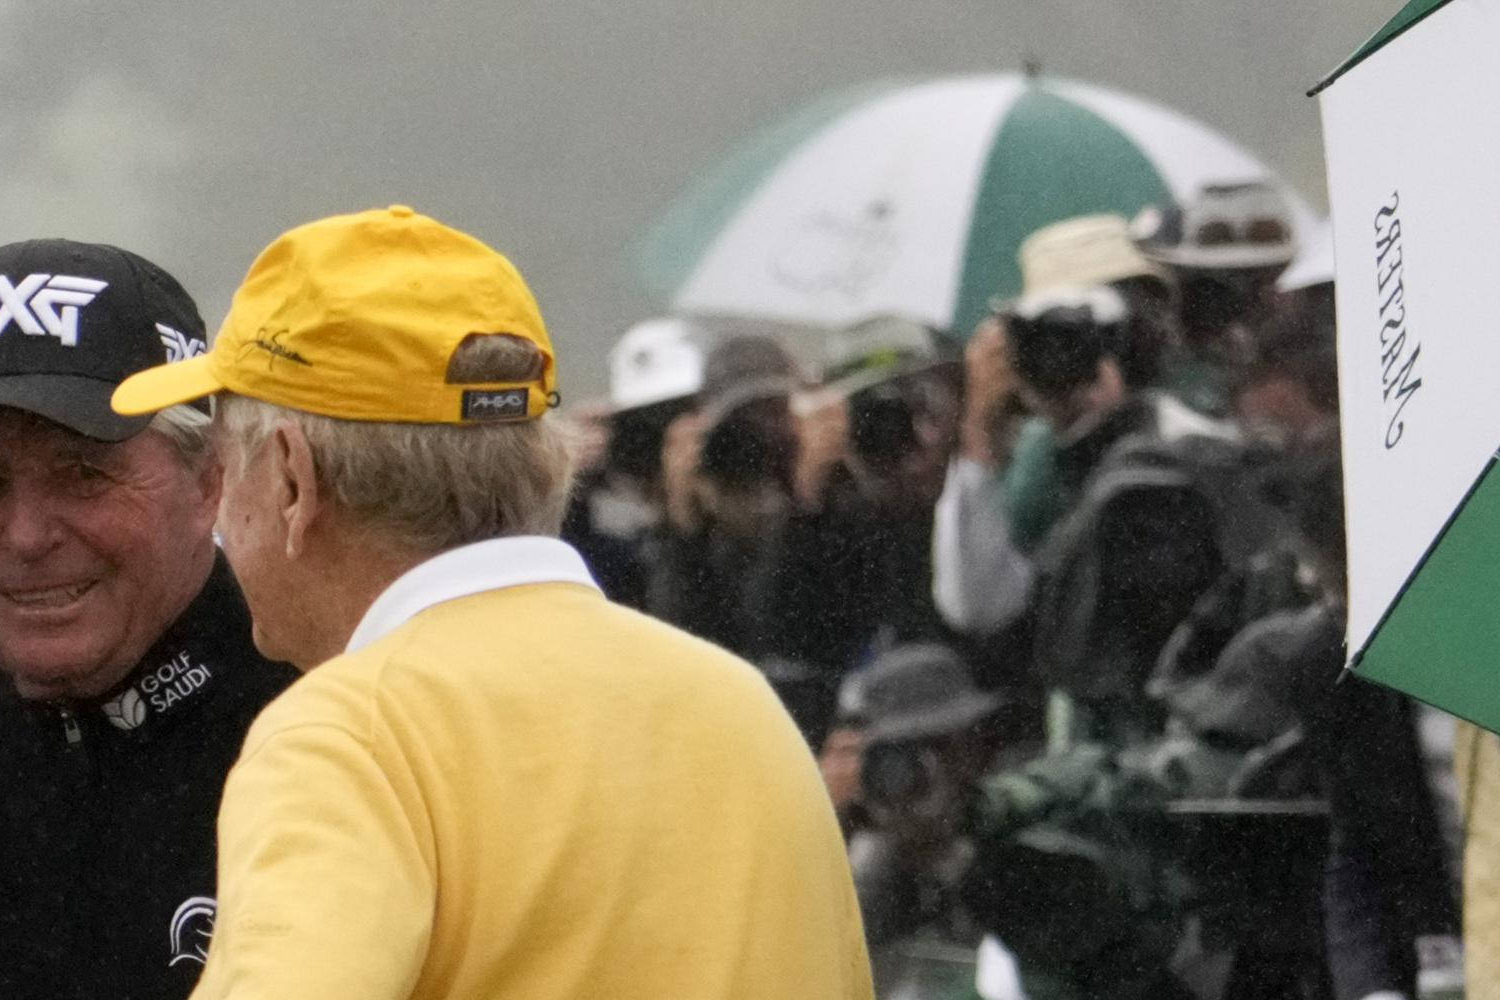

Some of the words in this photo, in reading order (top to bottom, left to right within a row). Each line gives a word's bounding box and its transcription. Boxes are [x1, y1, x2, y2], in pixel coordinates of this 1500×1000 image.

[155, 321, 206, 363] PX
[141, 650, 190, 693] GOLF
[150, 663, 211, 712] SAUDI
